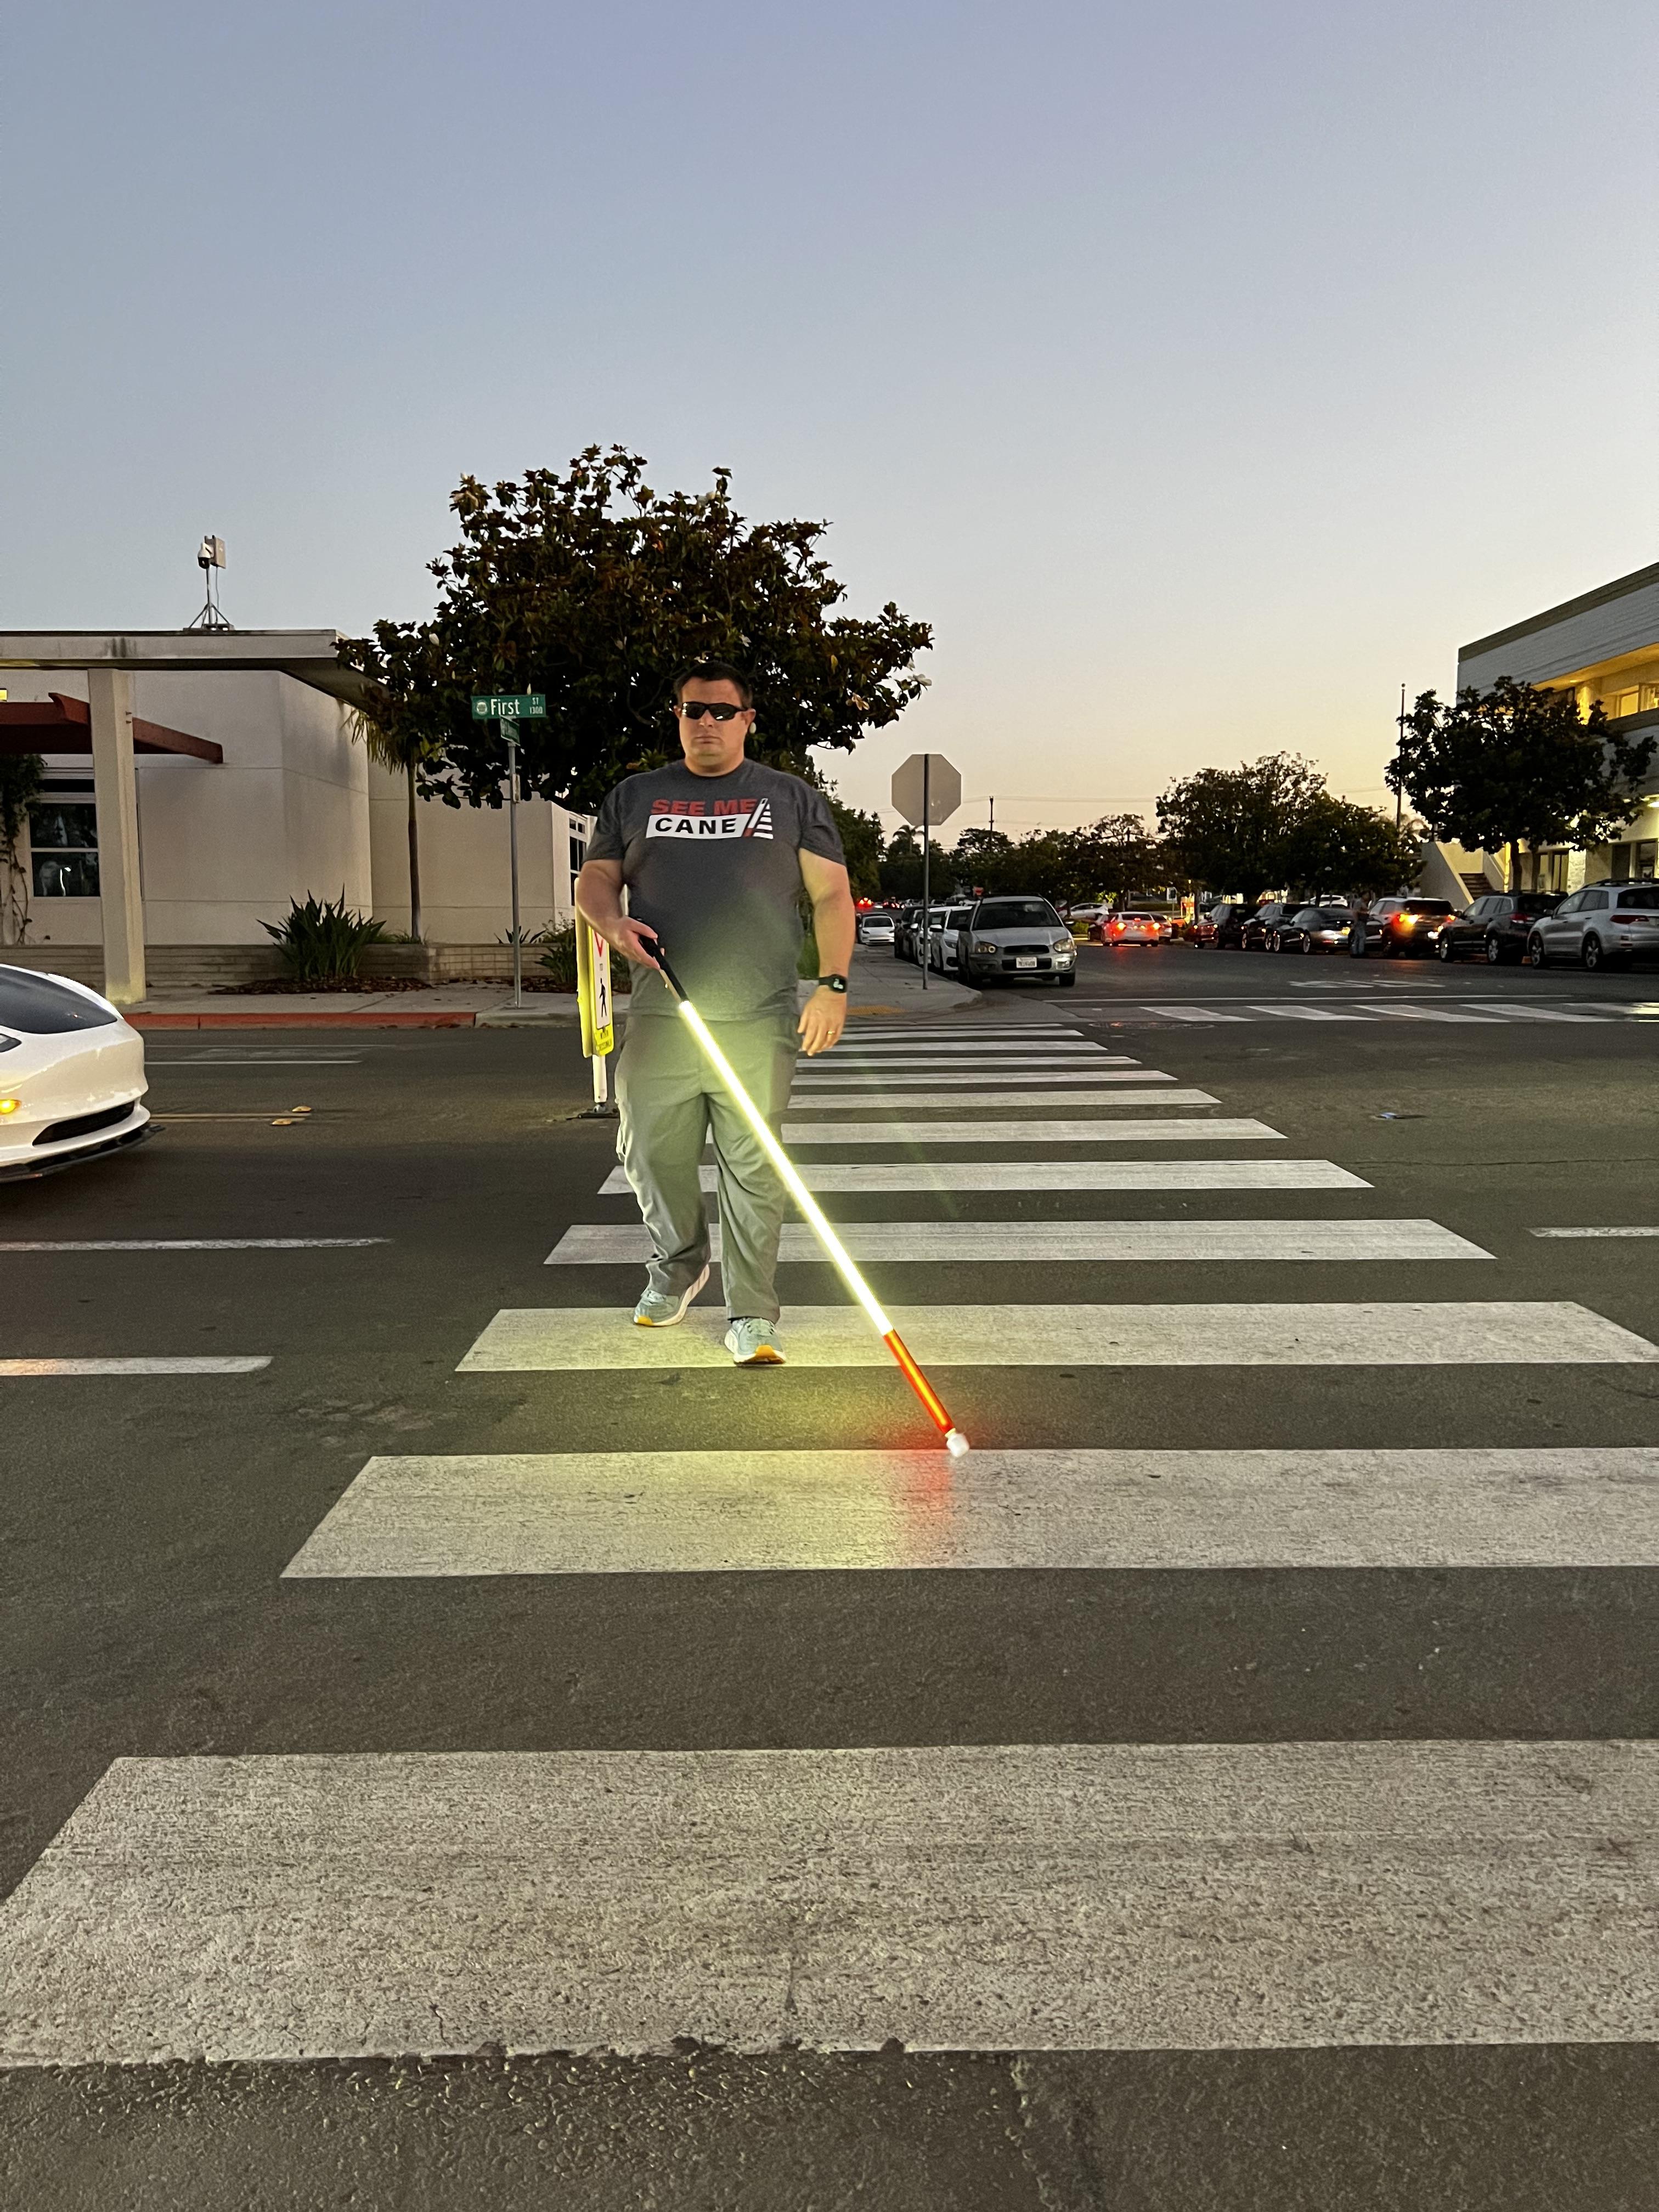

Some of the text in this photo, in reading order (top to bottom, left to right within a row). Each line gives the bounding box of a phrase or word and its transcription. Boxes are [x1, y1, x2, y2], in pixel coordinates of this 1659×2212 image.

[490, 698, 520, 715] First
[651, 798, 758, 816] SEE ME
[655, 817, 736, 834] CANE
